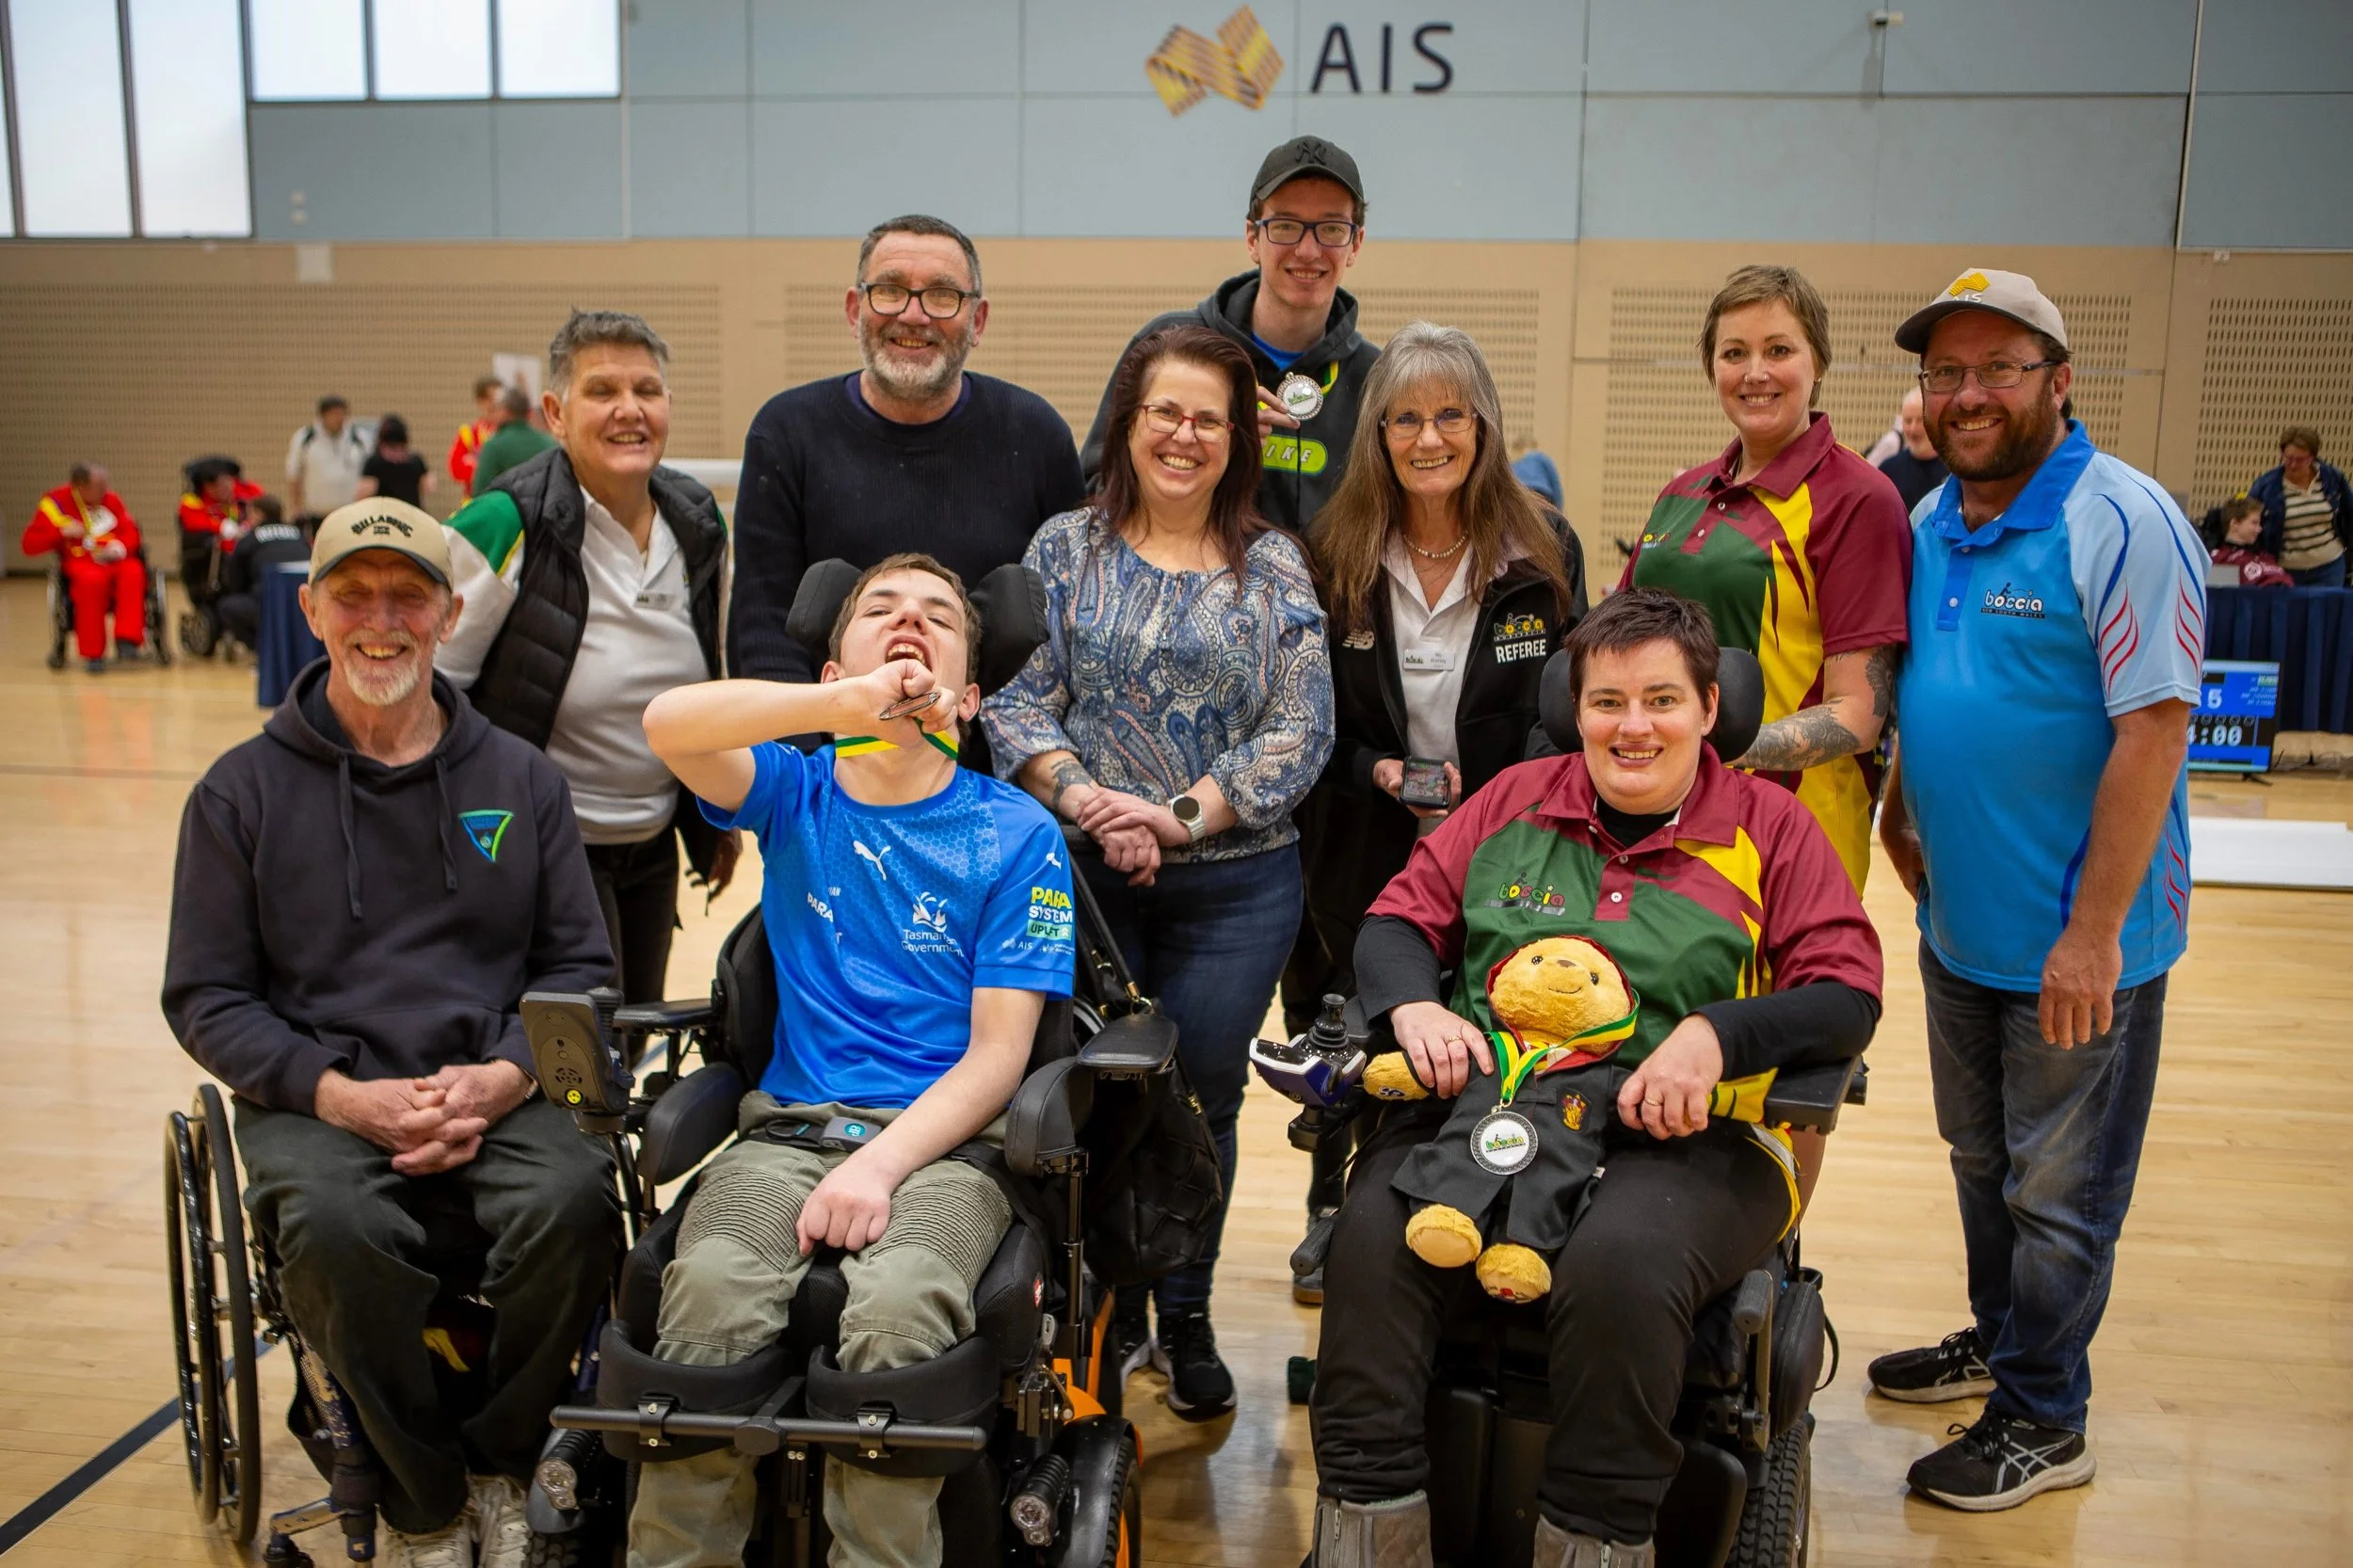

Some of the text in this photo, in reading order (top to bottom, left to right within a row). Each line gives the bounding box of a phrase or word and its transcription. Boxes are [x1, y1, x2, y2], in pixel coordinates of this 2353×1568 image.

[1309, 21, 1455, 95] AIS
[1265, 443, 1312, 462] IKE
[1984, 589, 2043, 613] boccia
[1496, 639, 1546, 664] REFEREE
[1498, 883, 1565, 907] boccia
[807, 891, 834, 923] PARA
[1028, 904, 1073, 923] SYSTEM
[1031, 922, 1059, 936] UPLFT
[901, 940, 965, 958] Governmn
[1017, 940, 1033, 951] AIS
